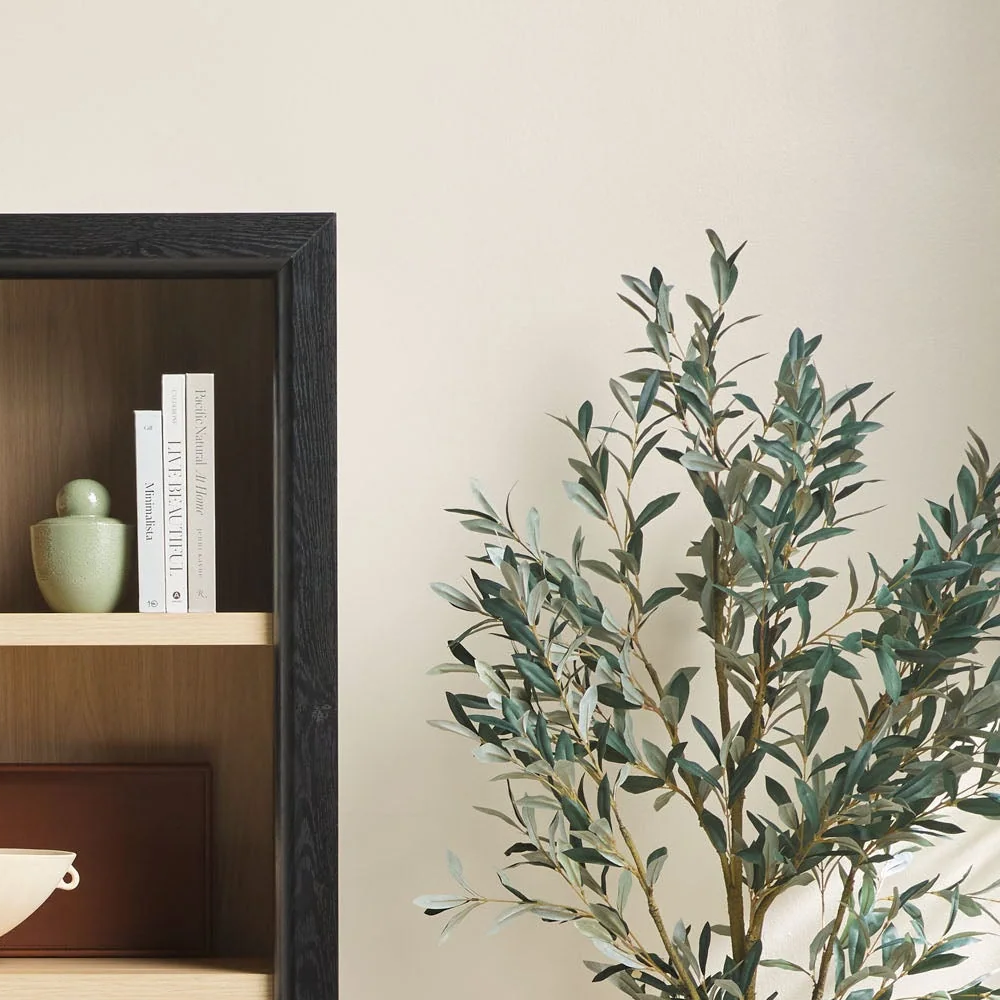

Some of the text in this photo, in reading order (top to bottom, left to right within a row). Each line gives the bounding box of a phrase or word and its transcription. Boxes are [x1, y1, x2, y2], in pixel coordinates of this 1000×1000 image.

[144, 482, 156, 542] Minimalista
[168, 441, 183, 577] LIVE BEAUTIFUL
[195, 390, 207, 516] Pacific Natural At Home
